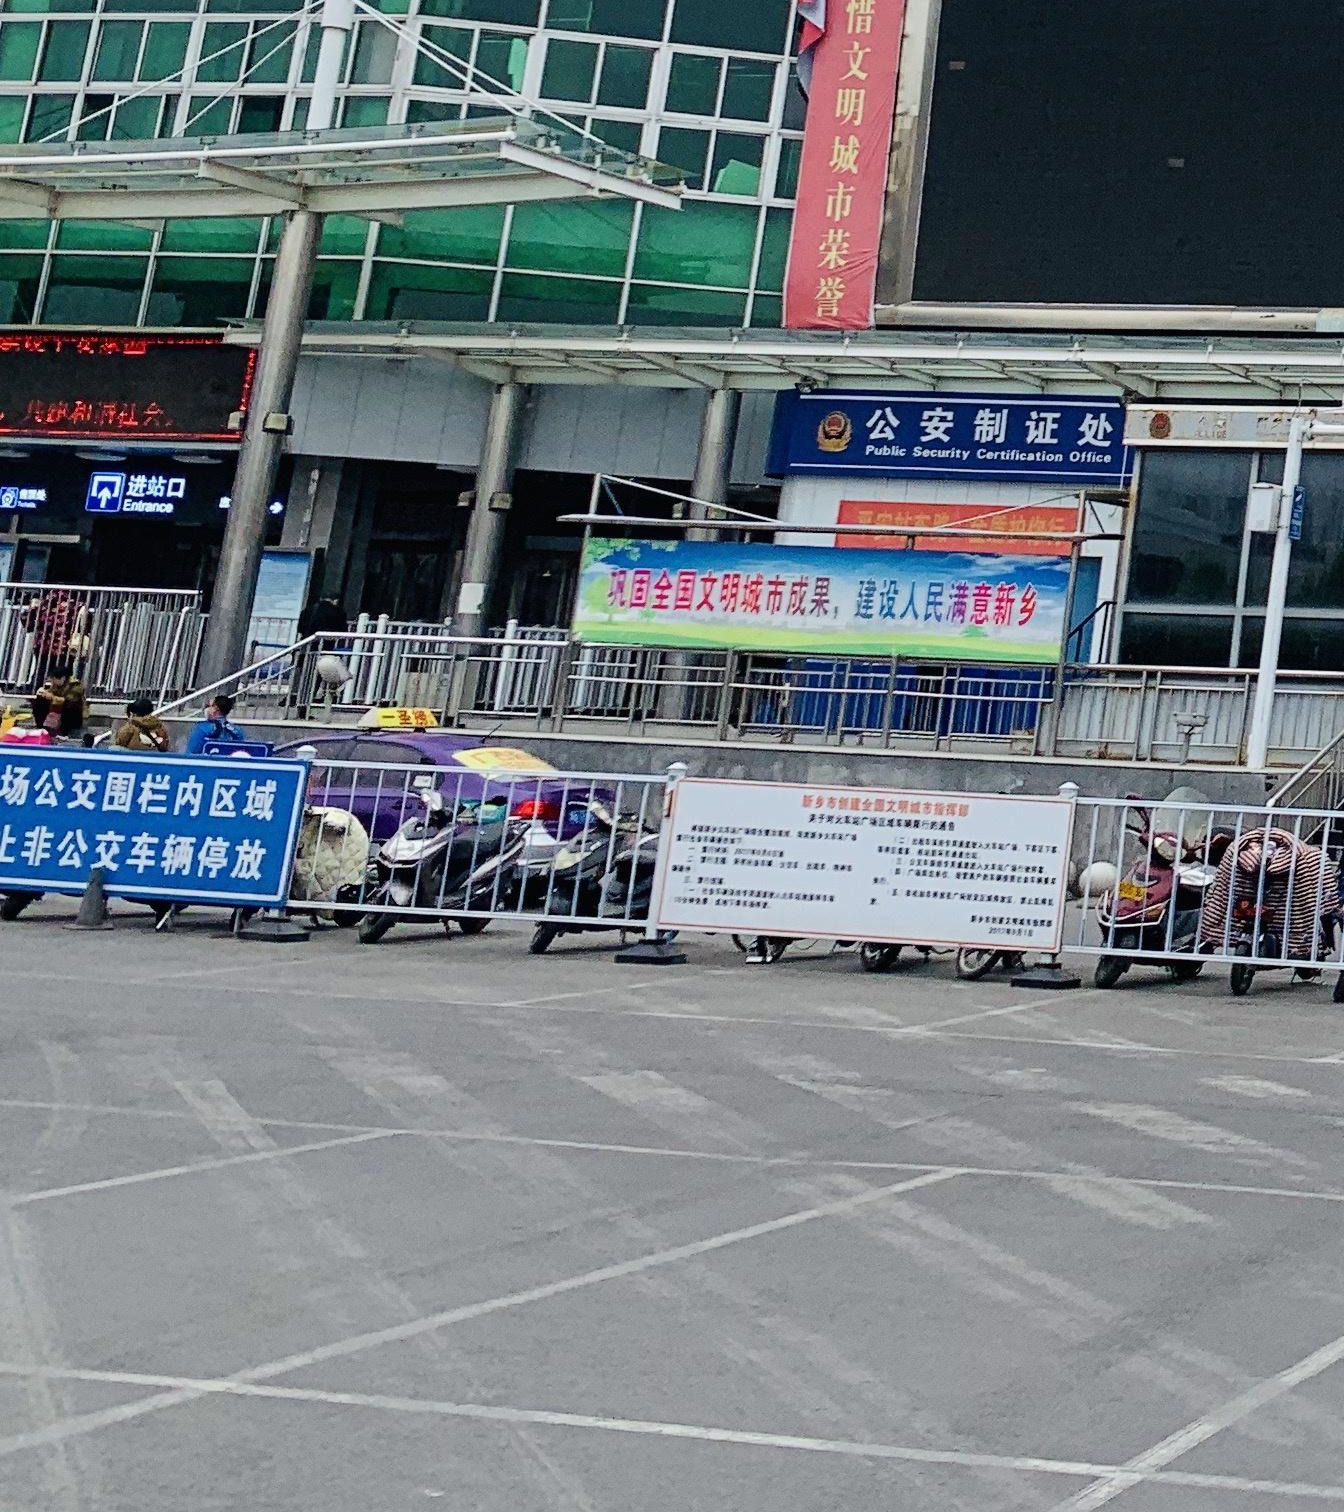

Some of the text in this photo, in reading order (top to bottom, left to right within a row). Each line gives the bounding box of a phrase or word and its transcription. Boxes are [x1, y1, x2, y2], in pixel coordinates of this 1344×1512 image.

[865, 406, 1113, 447] 公安制证处
[865, 445, 1112, 464] Public Security Certification Office
[126, 474, 187, 499] 进站口
[122, 499, 175, 514] Entrance
[0, 764, 278, 822] 场公交围栏内区域
